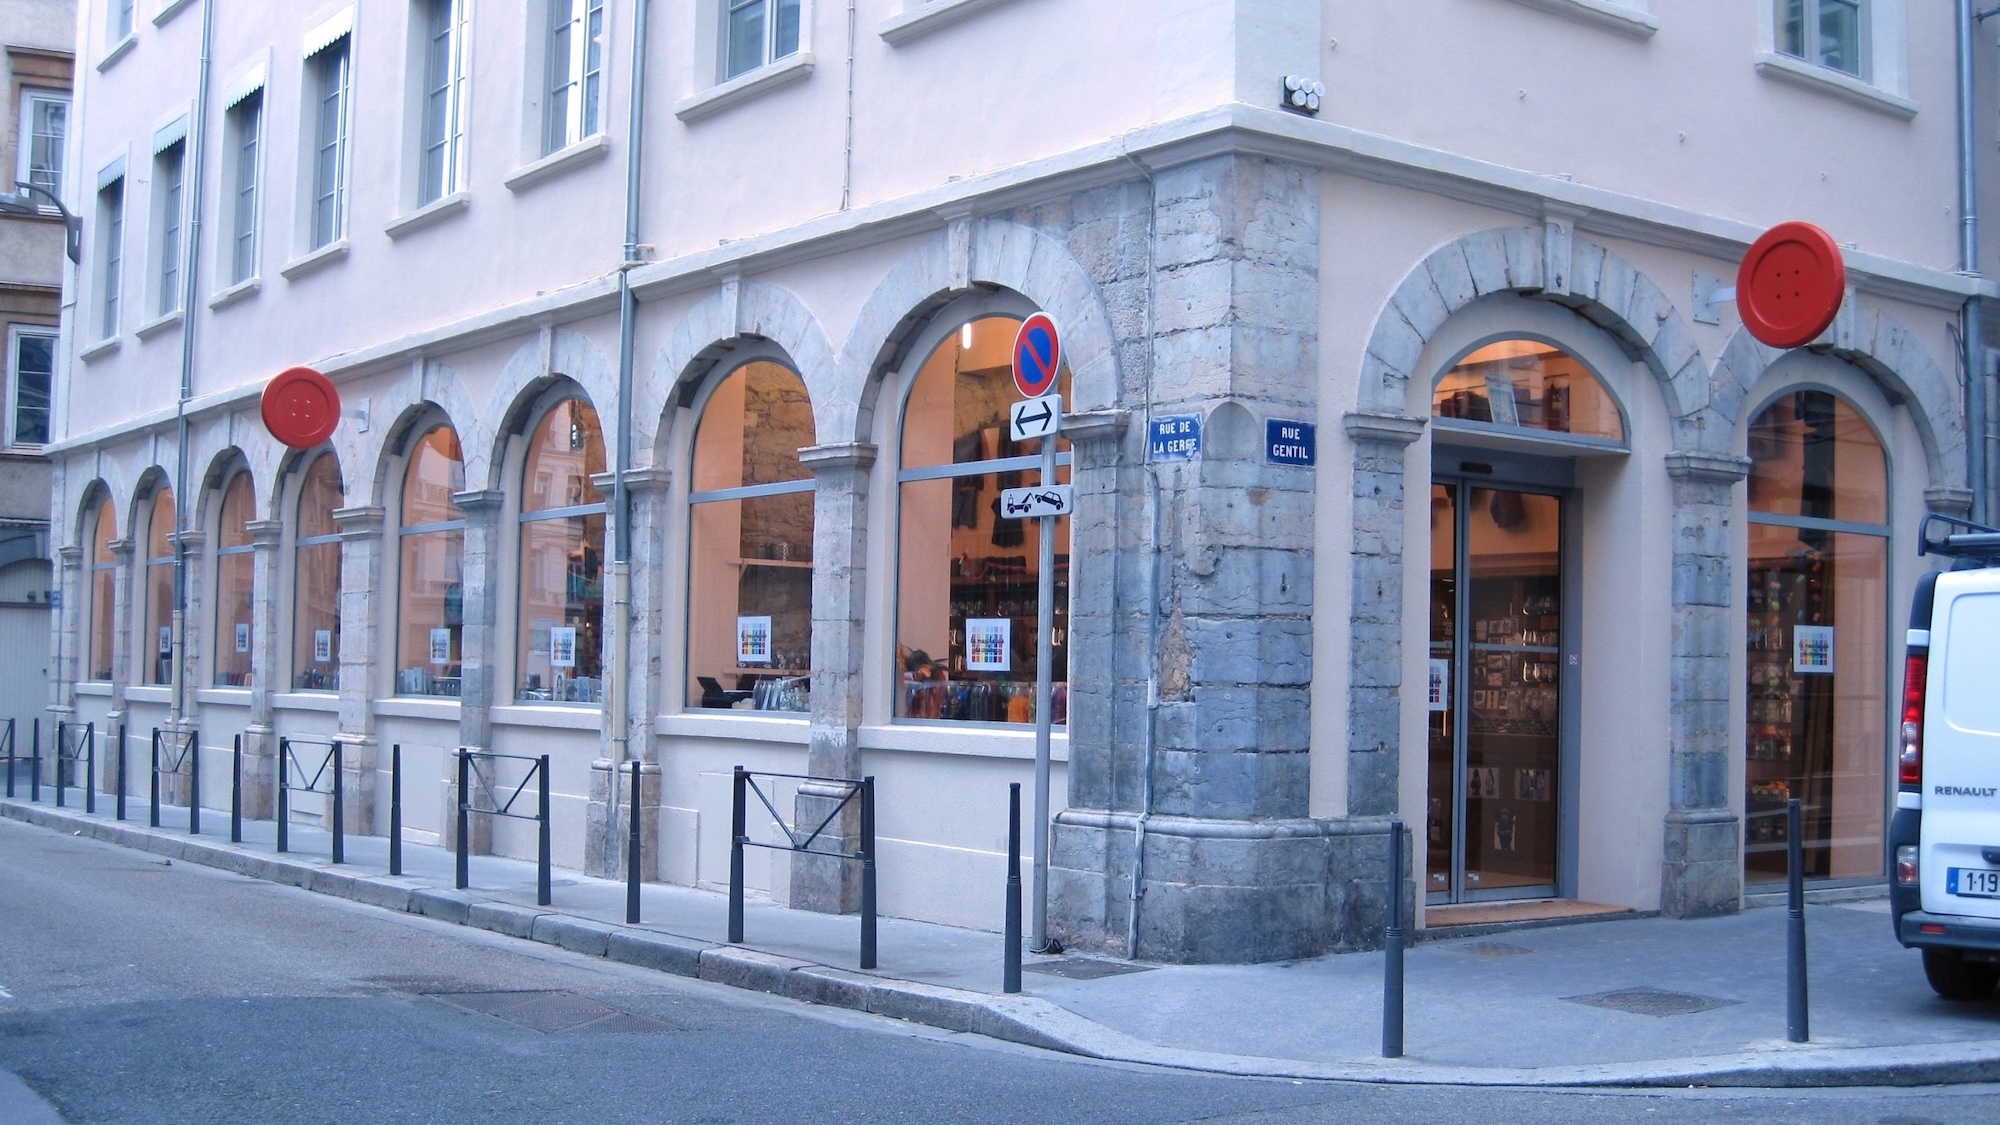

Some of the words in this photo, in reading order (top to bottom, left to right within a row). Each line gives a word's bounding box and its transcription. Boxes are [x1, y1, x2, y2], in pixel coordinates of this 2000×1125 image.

[1159, 422, 1176, 435] RUE
[1179, 420, 1191, 433] DE
[1281, 427, 1300, 440] RUE
[1153, 441, 1165, 454] LA
[1272, 444, 1309, 459] GENTIL
[1934, 785, 1998, 797] RENAULT
